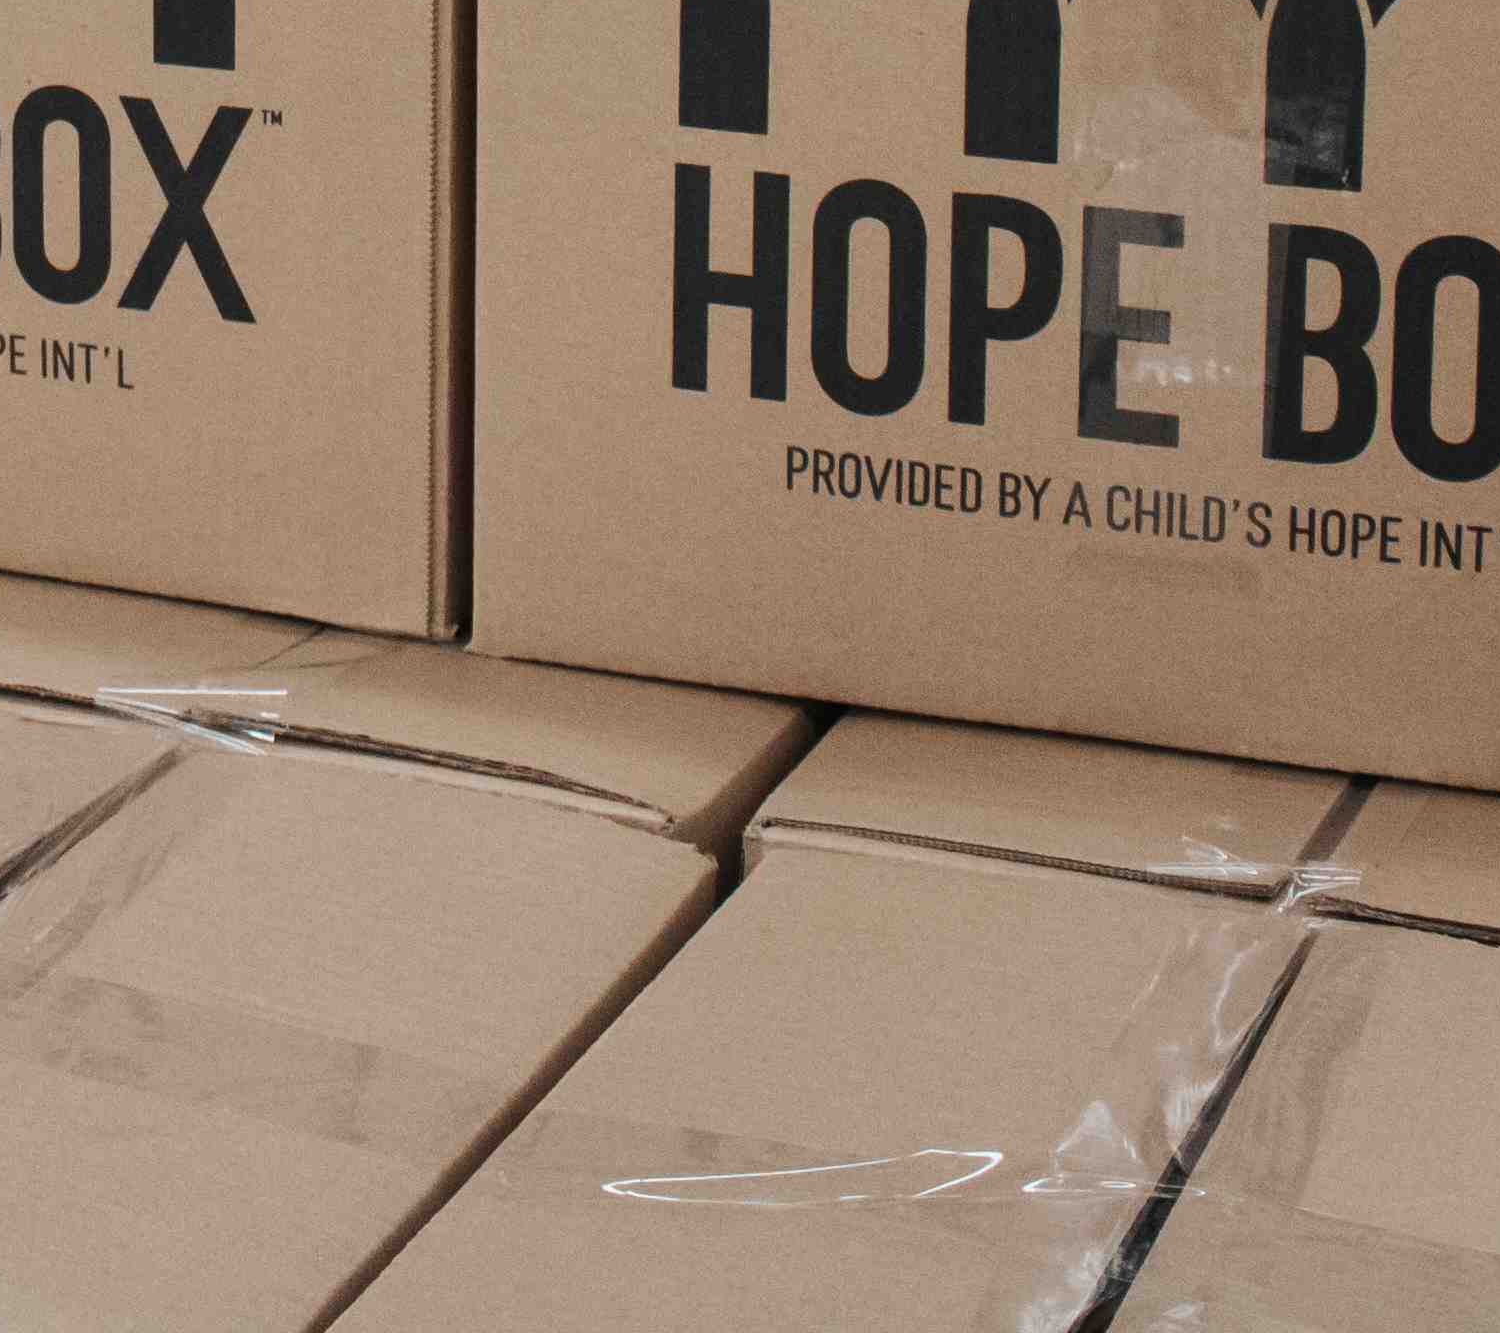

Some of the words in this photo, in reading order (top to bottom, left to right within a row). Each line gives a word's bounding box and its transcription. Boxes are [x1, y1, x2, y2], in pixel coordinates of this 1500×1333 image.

[40, 339, 136, 390] INT'L
[671, 162, 1186, 448] HOPE
[785, 445, 983, 514] PROVIDED
[998, 471, 1052, 522] BY
[1061, 480, 1093, 528] A
[1105, 485, 1273, 549] CHILD'S
[1289, 506, 1403, 564] HOPE
